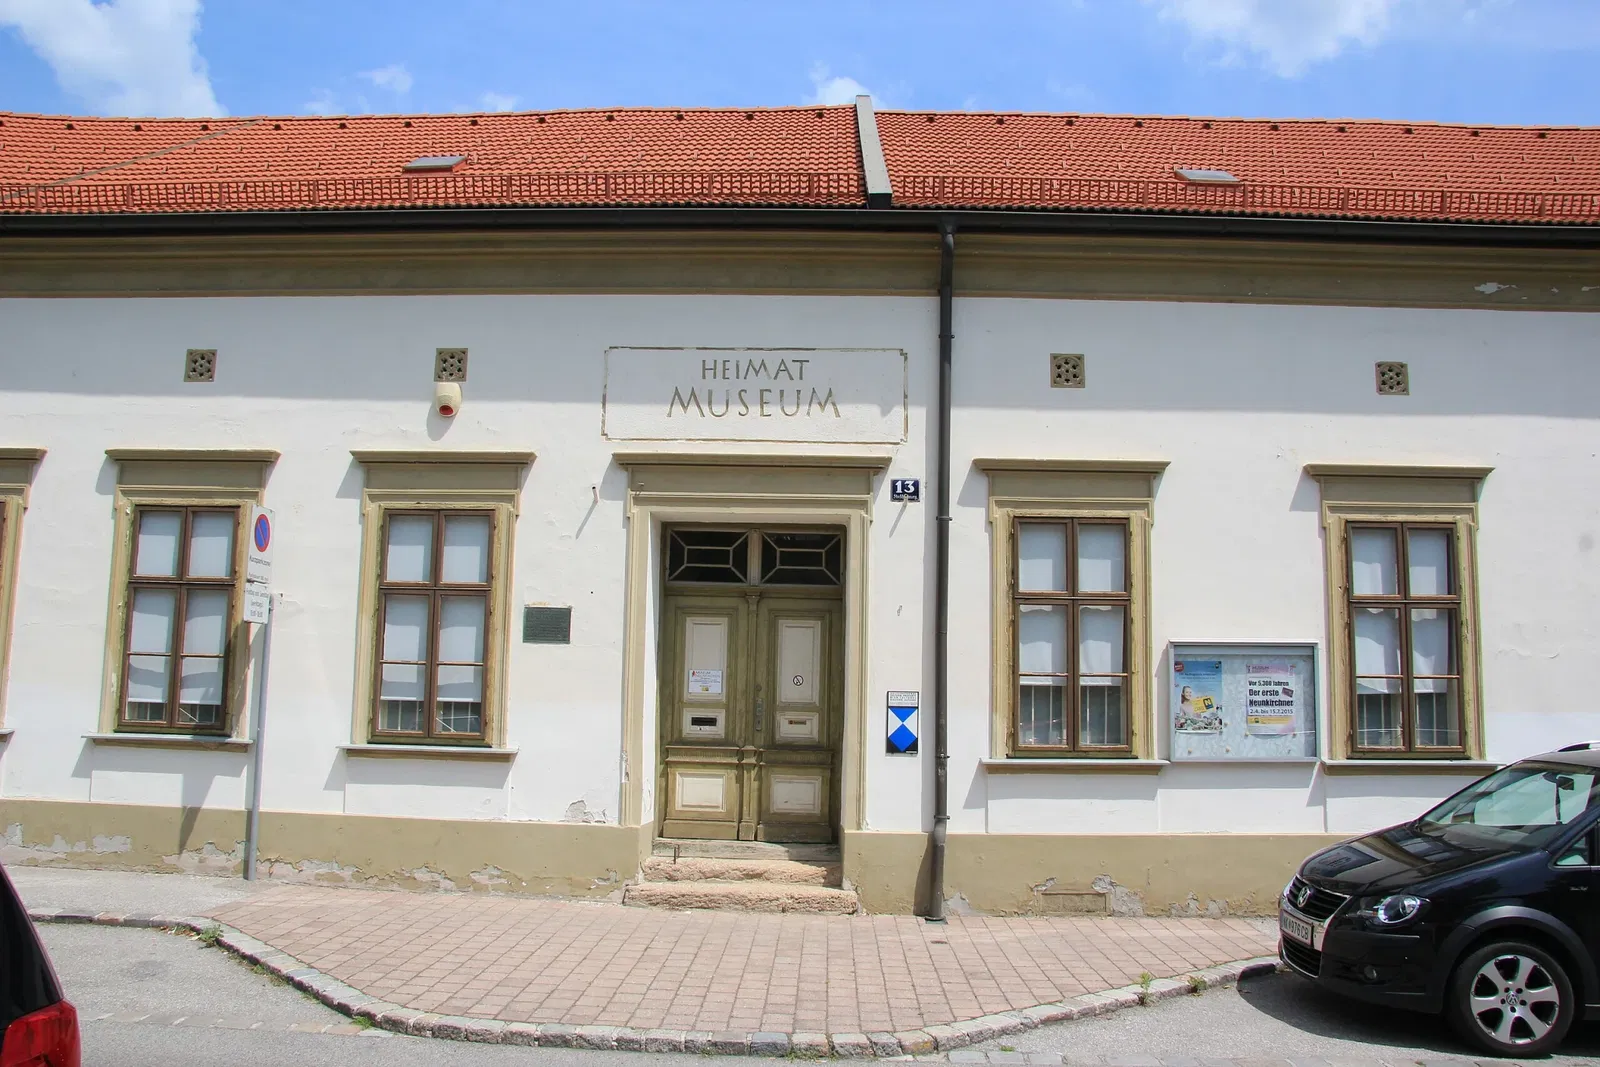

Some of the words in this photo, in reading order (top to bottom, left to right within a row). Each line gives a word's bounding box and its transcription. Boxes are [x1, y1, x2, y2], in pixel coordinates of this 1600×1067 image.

[702, 359, 809, 380] HEIMAT
[667, 387, 841, 418] MUSEUM
[895, 480, 914, 493] 13
